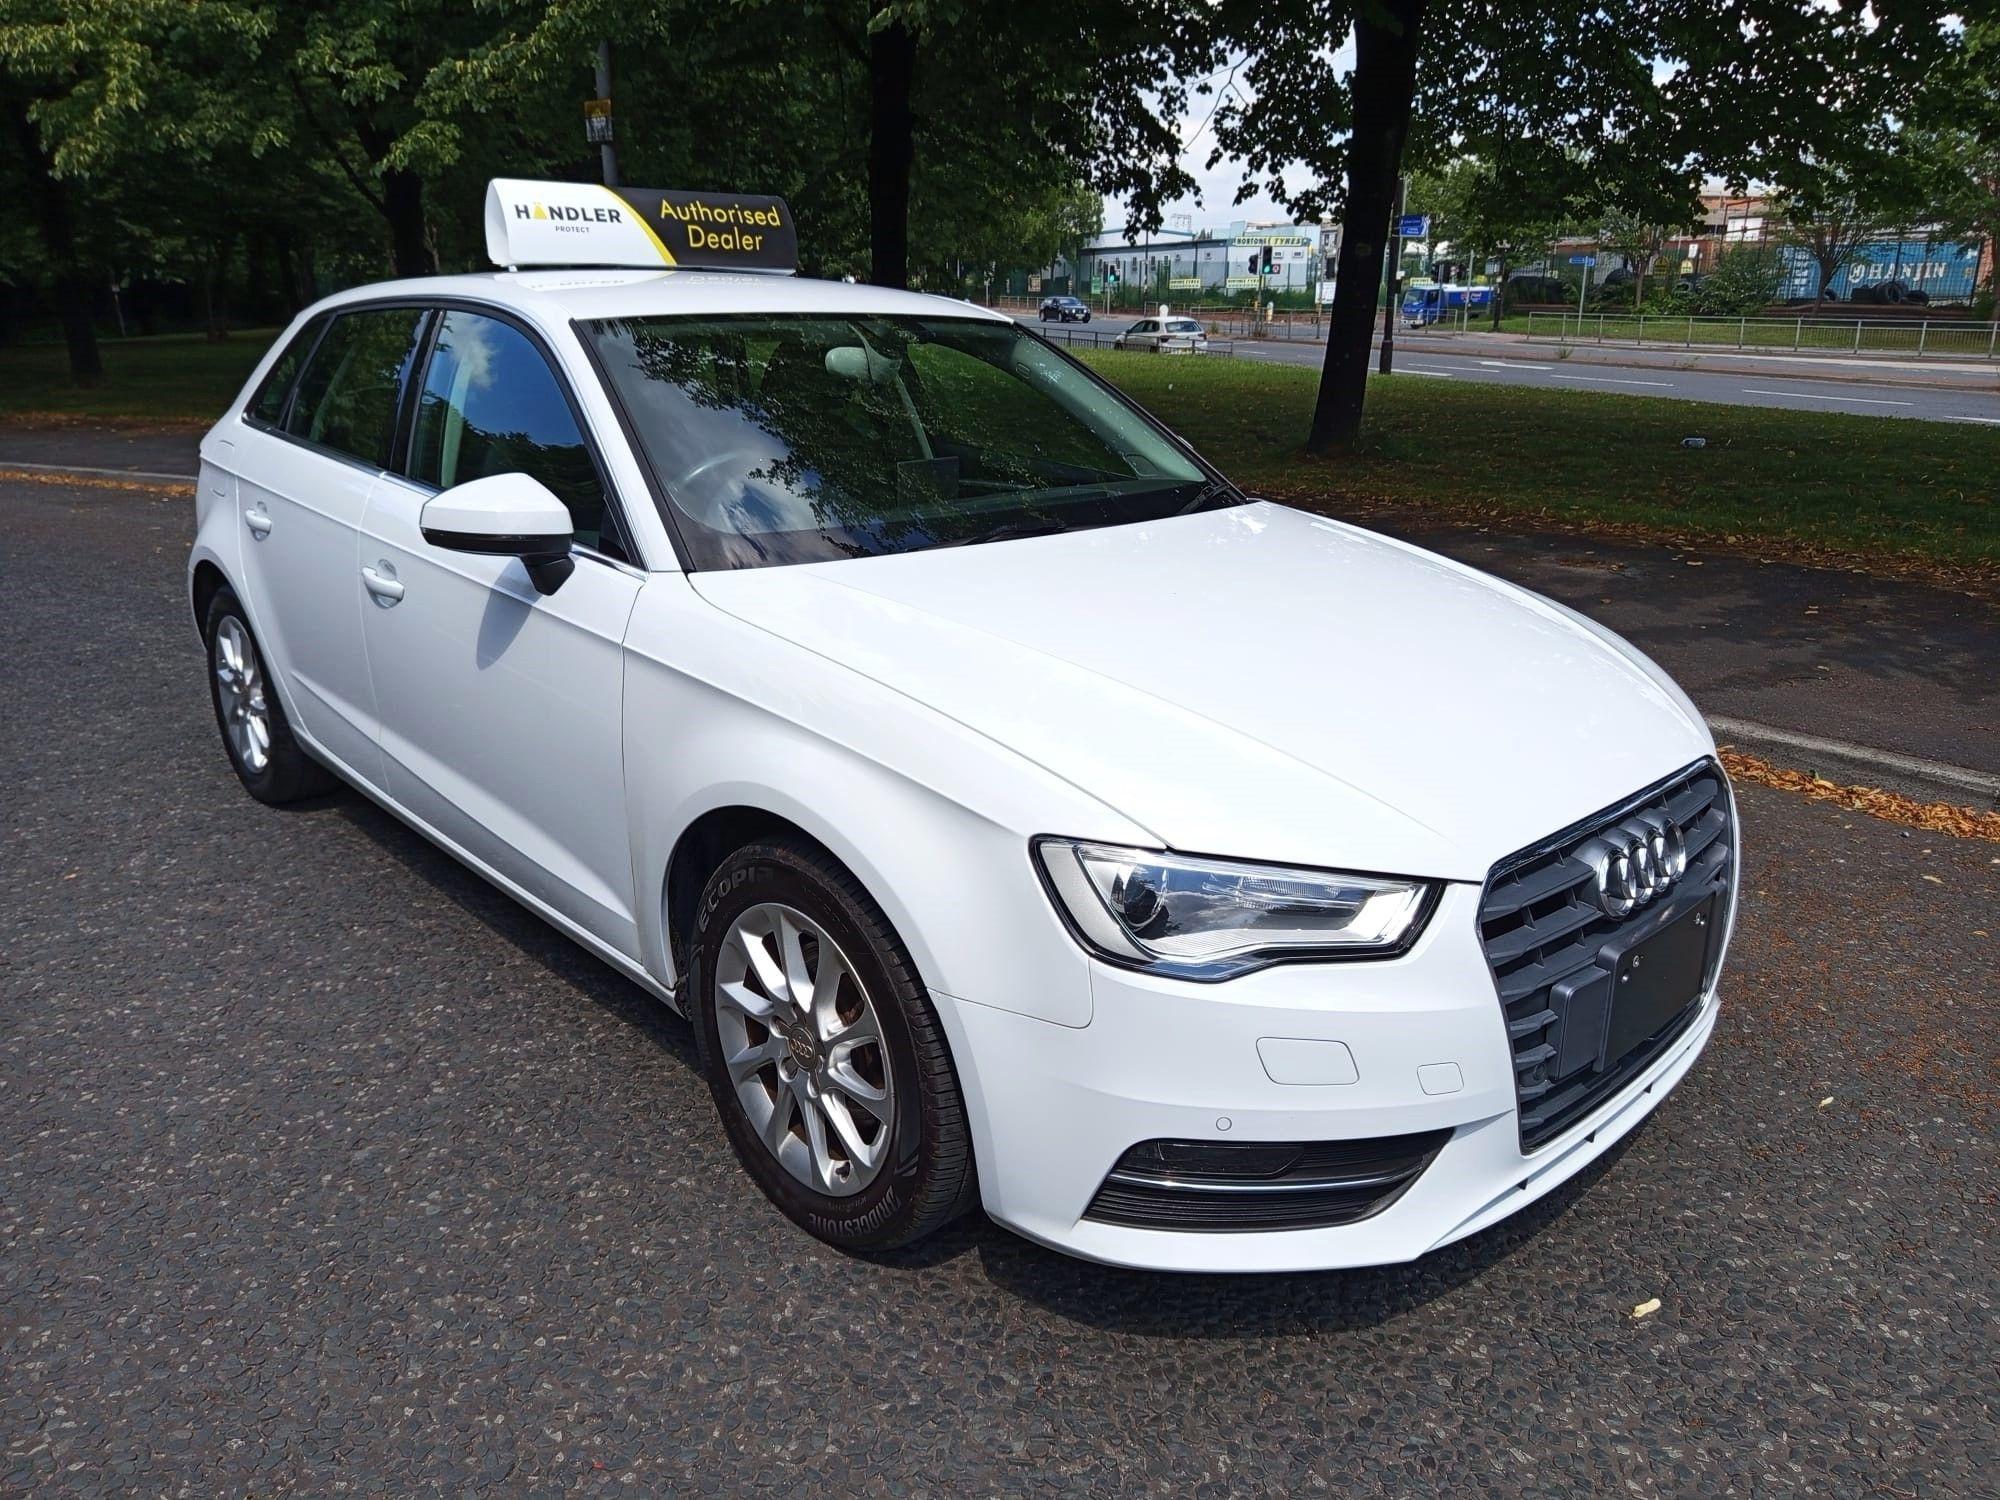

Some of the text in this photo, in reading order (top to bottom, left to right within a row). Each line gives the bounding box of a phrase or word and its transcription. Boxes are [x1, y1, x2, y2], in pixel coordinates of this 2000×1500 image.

[660, 199, 781, 227] Authorised
[554, 225, 590, 234] PROTECT
[687, 224, 764, 251] Dealer
[1867, 262, 1947, 282] HANJIN
